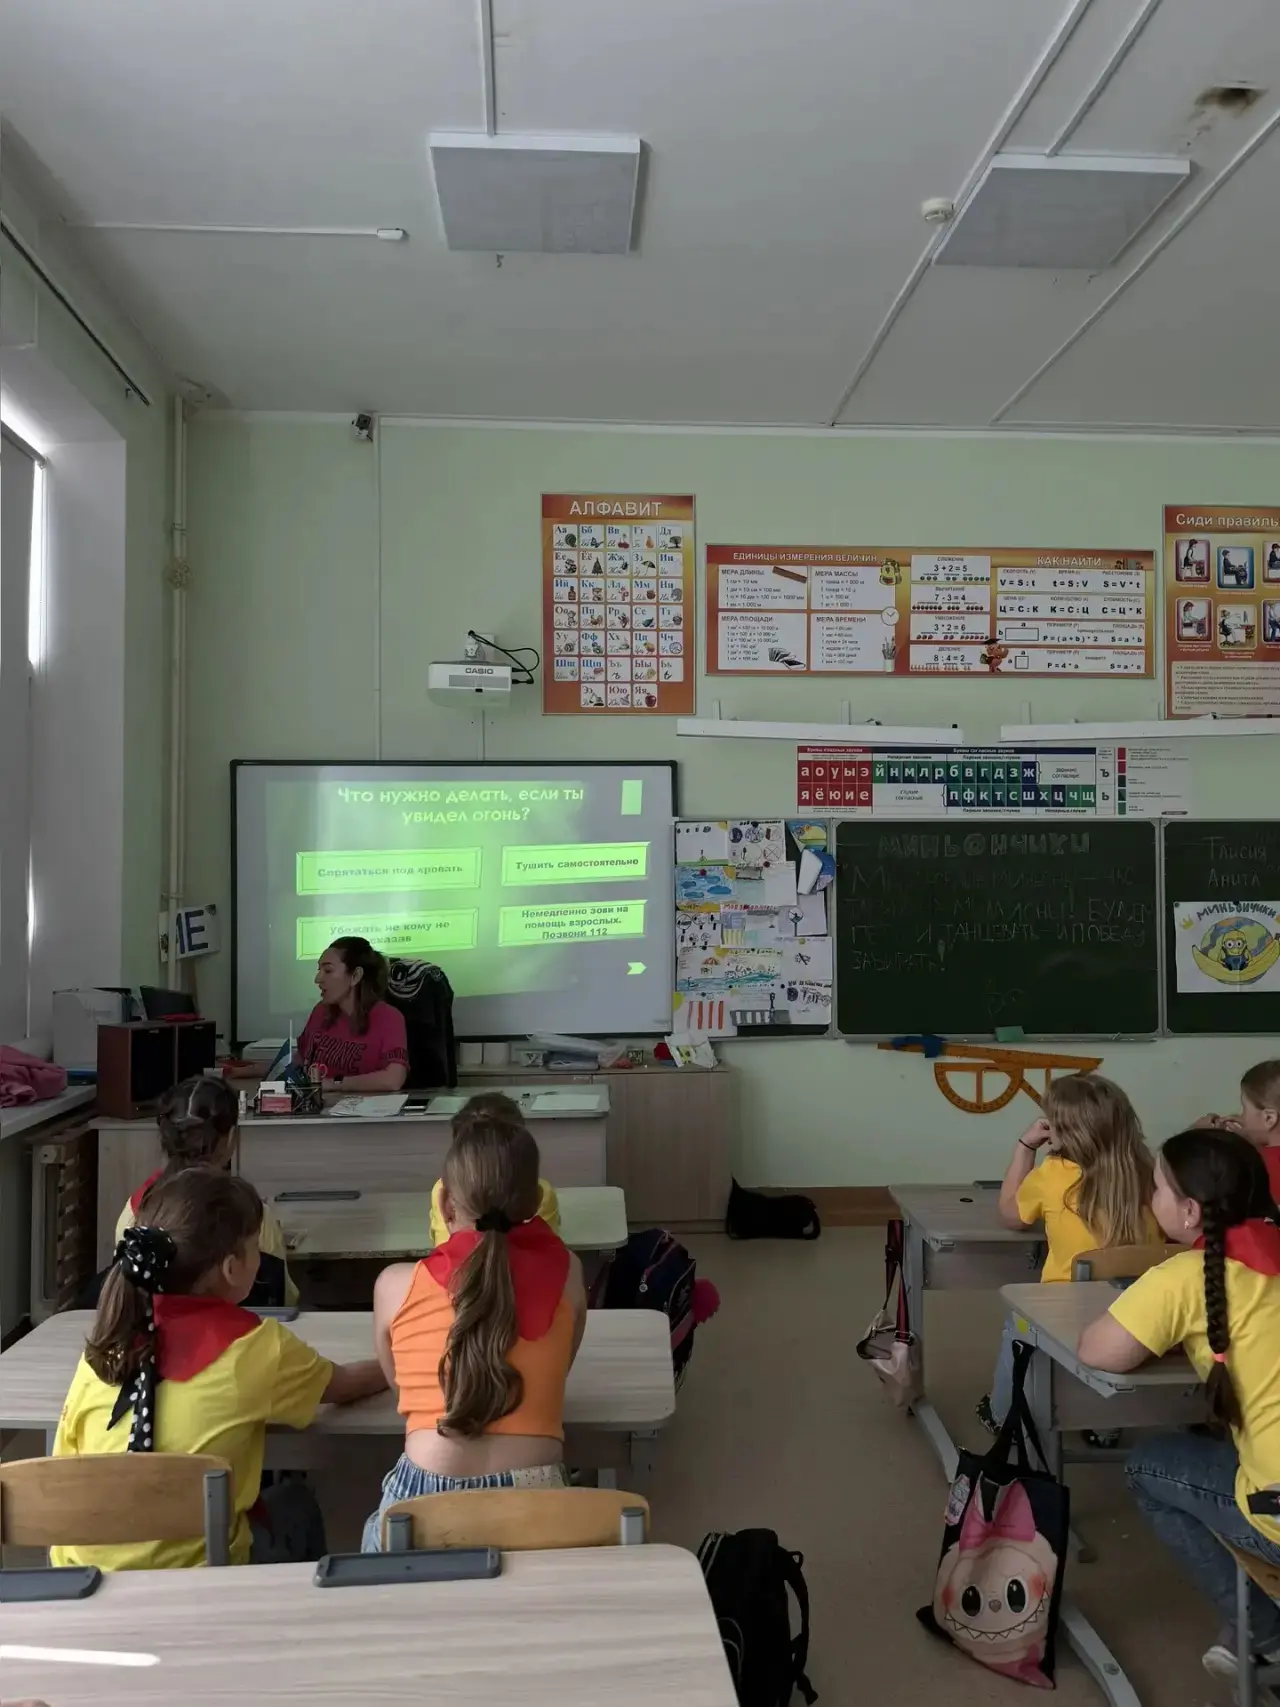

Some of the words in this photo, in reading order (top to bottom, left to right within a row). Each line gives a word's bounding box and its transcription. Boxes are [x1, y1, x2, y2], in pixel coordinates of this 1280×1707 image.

[569, 501, 663, 516] АЛФАВИТ
[1176, 513, 1213, 527] Сиди
[733, 552, 777, 562] ЕДИНИЦЫ
[780, 553, 834, 562] ИЗМЕРЕНИЯ
[836, 554, 877, 562] ВЕЛИЧИН
[1037, 557, 1060, 566] КАК
[801, 767, 810, 776] а
[815, 767, 824, 776] о
[831, 767, 840, 780] у
[844, 768, 856, 776] ы
[860, 767, 870, 776] э
[875, 764, 884, 777] й
[890, 768, 898, 777] н
[904, 768, 915, 777] м
[919, 768, 929, 777] л
[934, 768, 944, 780] р
[950, 765, 959, 777] б
[965, 768, 974, 777] в
[980, 768, 988, 777] г
[994, 769, 1004, 780] д
[1010, 768, 1018, 778] з
[1023, 768, 1035, 778] ж
[338, 787, 374, 802] Что
[380, 789, 440, 804] нужно
[446, 789, 513, 804] делать,
[518, 790, 558, 800] если
[564, 788, 584, 800] ты
[802, 791, 810, 800] я
[815, 788, 824, 800] ё
[829, 791, 841, 800] ю
[845, 791, 854, 800] и
[860, 791, 869, 800] е
[950, 792, 958, 800] п
[964, 788, 974, 803] ф
[980, 792, 988, 800] к
[994, 792, 1003, 800] т
[1009, 792, 1018, 800] с
[1023, 792, 1034, 800] ш
[1040, 792, 1048, 800] х
[1054, 792, 1064, 802] ц
[1070, 792, 1078, 800] ч
[1082, 792, 1094, 803] щ
[402, 810, 468, 826] увидел
[473, 808, 531, 823] огонь?
[317, 866, 389, 878] Спрятаться
[392, 866, 414, 876] под
[418, 864, 463, 876] кровать
[516, 860, 555, 872] Тушить
[558, 858, 640, 869] самостоятельно
[522, 908, 588, 919] Немедленно
[590, 907, 614, 917] зови
[616, 906, 630, 914] на
[330, 925, 381, 935] Убежать
[386, 924, 400, 932] не
[404, 923, 432, 931] кому
[524, 919, 566, 930] помощь
[568, 916, 622, 928] взрослых.
[176, 909, 208, 955] Е
[542, 928, 587, 940] Позвони
[590, 928, 608, 937] 112
